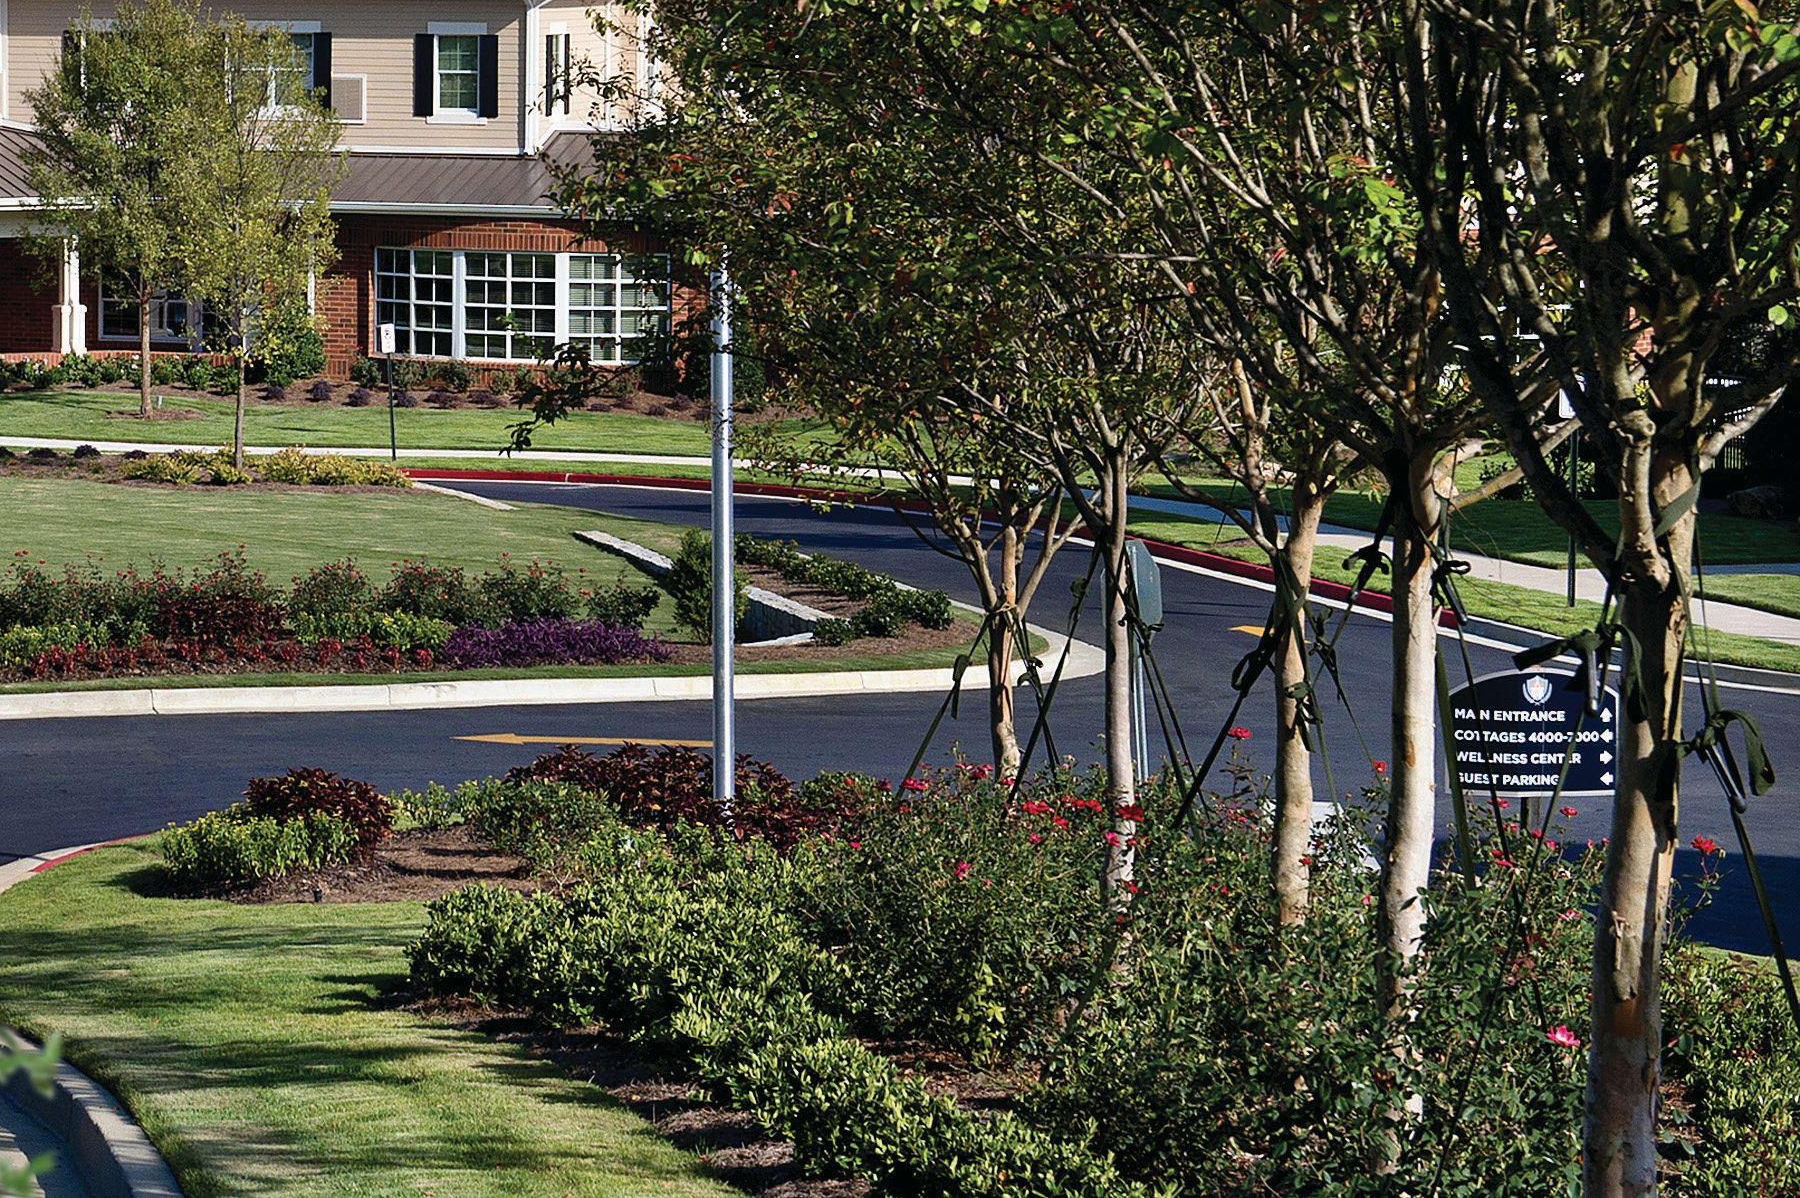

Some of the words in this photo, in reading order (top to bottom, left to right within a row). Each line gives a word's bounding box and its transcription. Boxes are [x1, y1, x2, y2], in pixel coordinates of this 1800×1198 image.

[1454, 708, 1490, 720] MAN
[1493, 710, 1566, 721] ENTRANCE
[1528, 731, 1600, 743] 4000-7000
[1530, 753, 1582, 764] CENTR
[1502, 774, 1560, 786] PARKING
